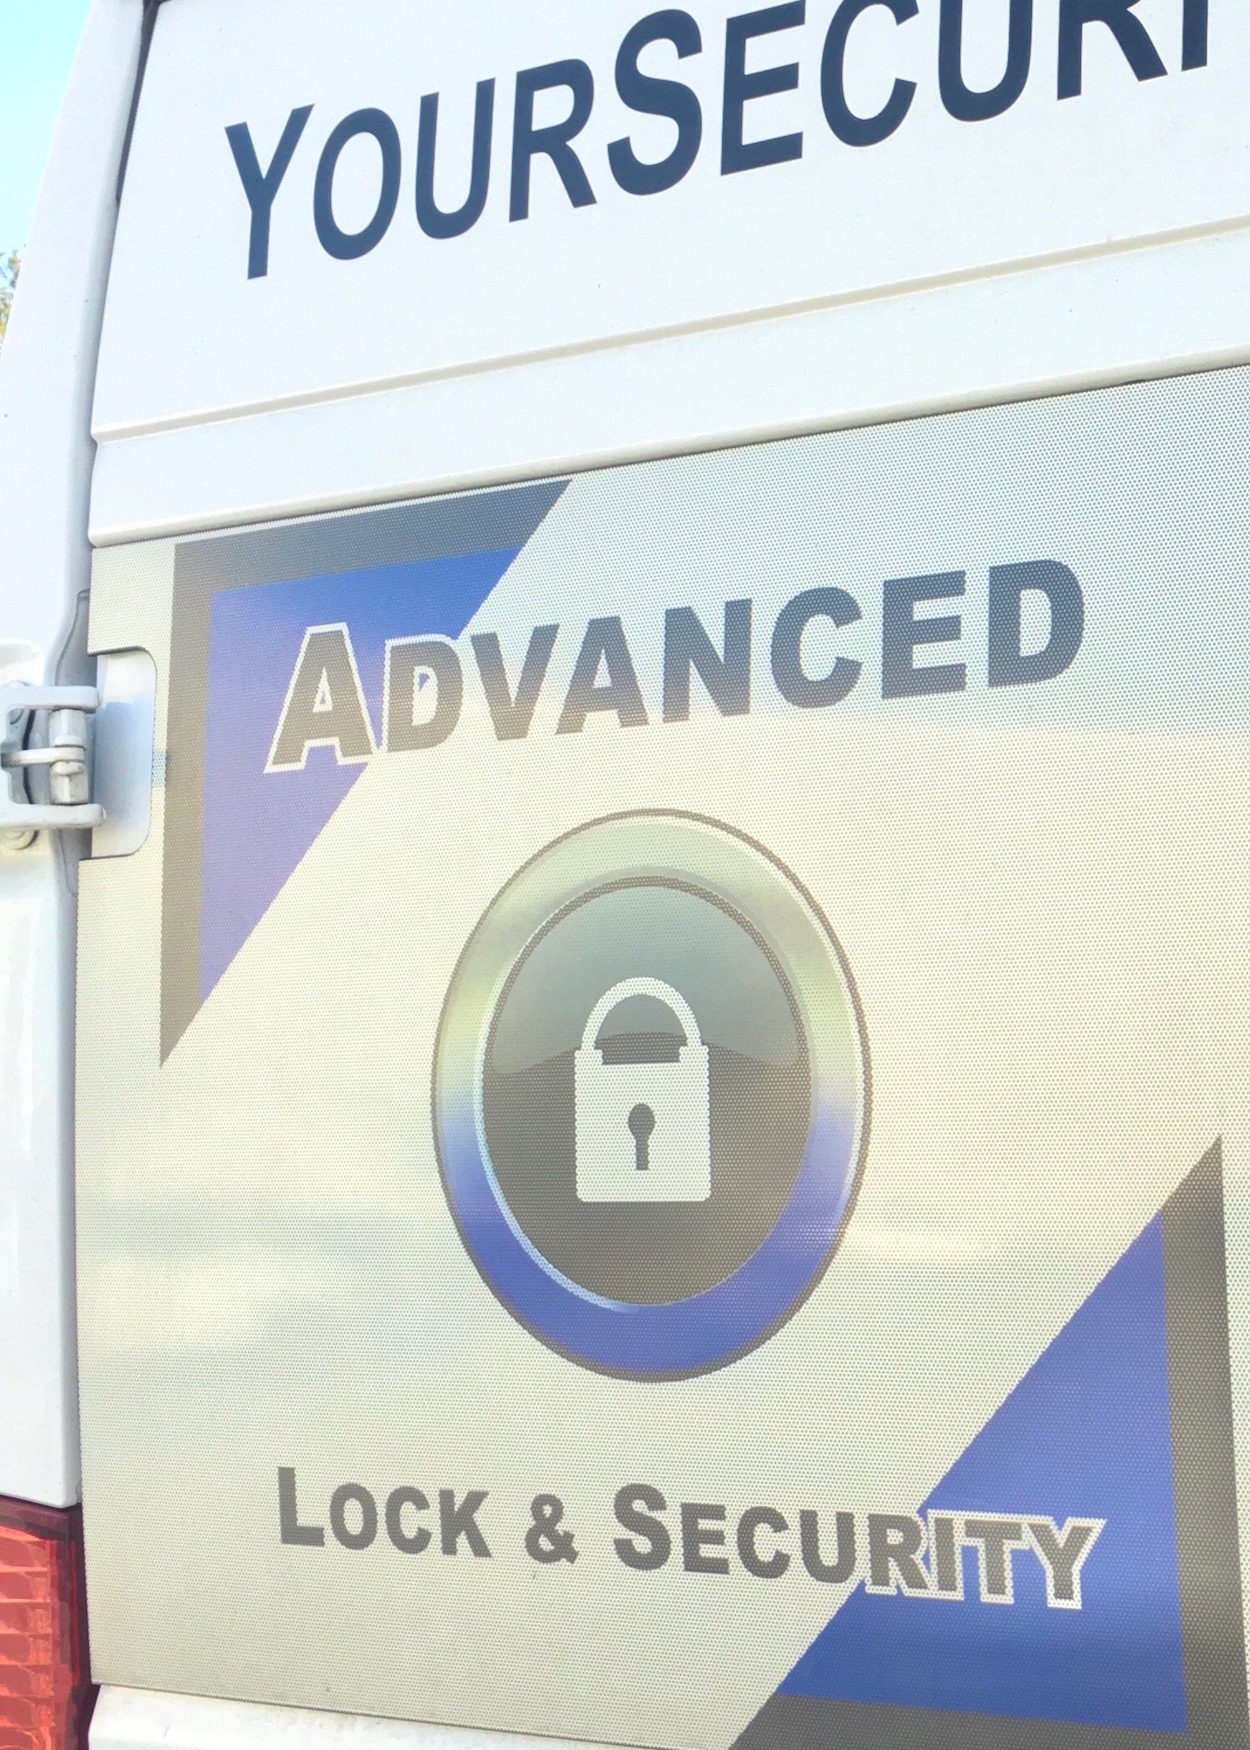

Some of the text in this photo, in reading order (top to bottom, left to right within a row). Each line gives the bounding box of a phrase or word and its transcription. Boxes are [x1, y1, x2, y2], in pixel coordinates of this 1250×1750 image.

[264, 558, 1086, 774] ADVANCED
[277, 1466, 1106, 1610] LOCK & SECURITY
